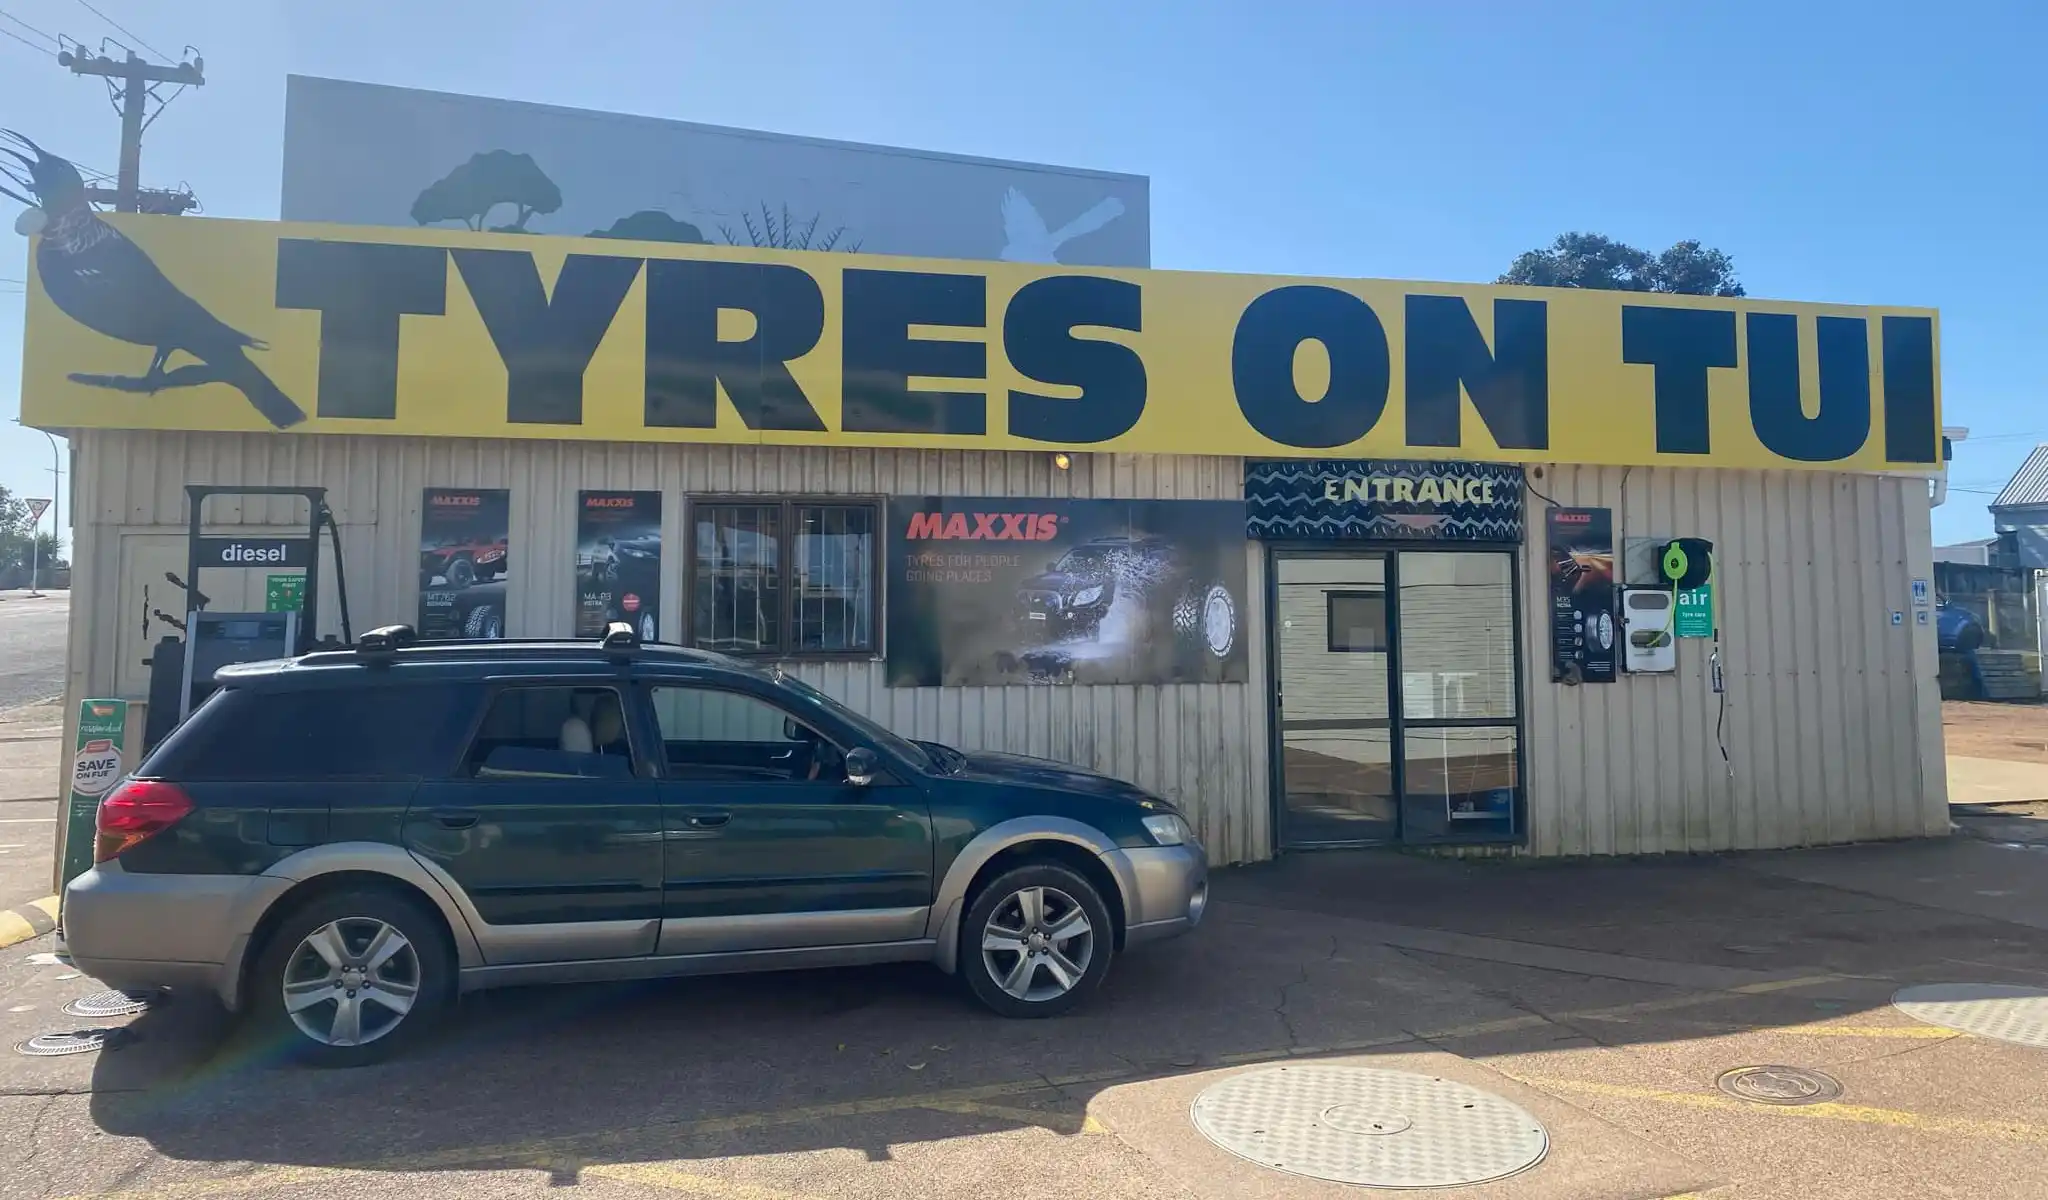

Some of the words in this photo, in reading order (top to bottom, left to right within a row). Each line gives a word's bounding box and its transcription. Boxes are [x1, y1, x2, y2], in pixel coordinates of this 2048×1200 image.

[276, 238, 1148, 444] TYRES
[1231, 285, 1549, 451] ON
[1622, 304, 1937, 464] TUI
[1324, 477, 1494, 504] ENTRANCE
[430, 495, 480, 506] MAXXIS
[585, 498, 634, 508] MAXXIS
[906, 511, 1058, 541] MAXXIS
[221, 543, 287, 561] diesel
[906, 554, 945, 567] TYRES
[948, 554, 972, 567] FOR
[975, 555, 1021, 567] PEOPLE
[906, 570, 943, 583] GOING
[946, 570, 992, 583] PLACES
[1680, 589, 1708, 606] air
[77, 759, 116, 772] SAVE
[76, 772, 90, 780] ON
[92, 770, 112, 778] FUE
